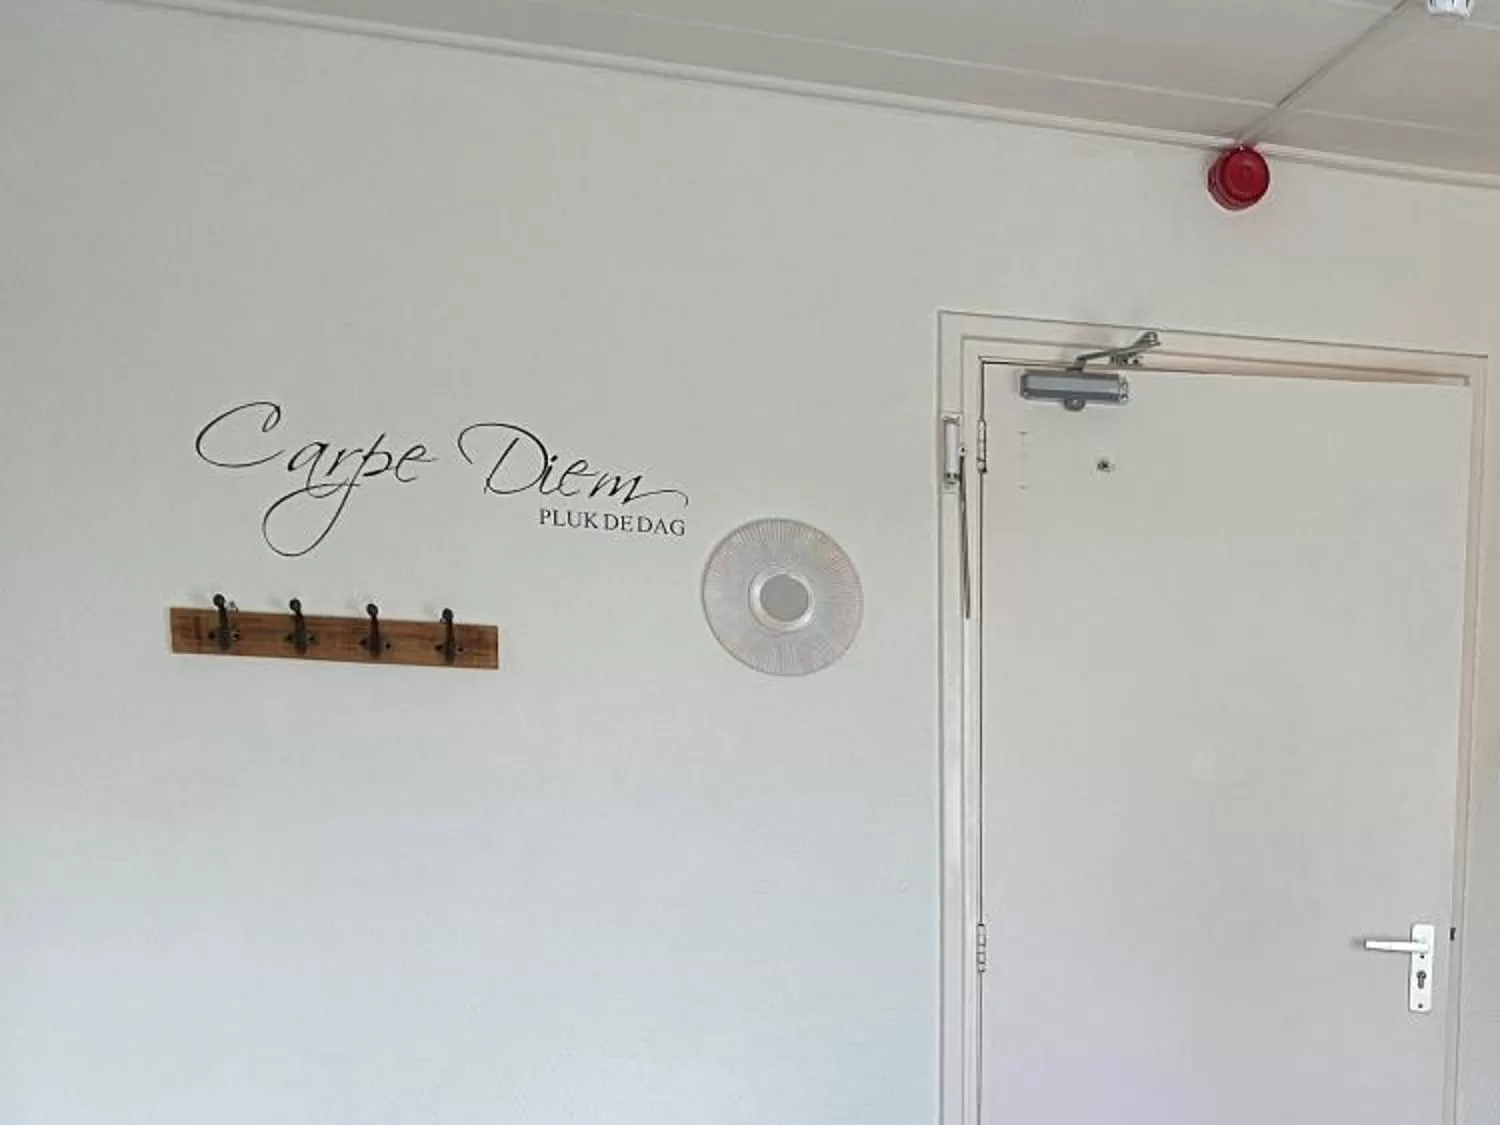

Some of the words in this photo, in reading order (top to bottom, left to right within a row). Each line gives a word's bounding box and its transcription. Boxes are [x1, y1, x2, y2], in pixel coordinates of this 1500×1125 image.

[195, 401, 438, 557] Carpe
[457, 422, 689, 507] Diem
[538, 508, 599, 529] PLUK
